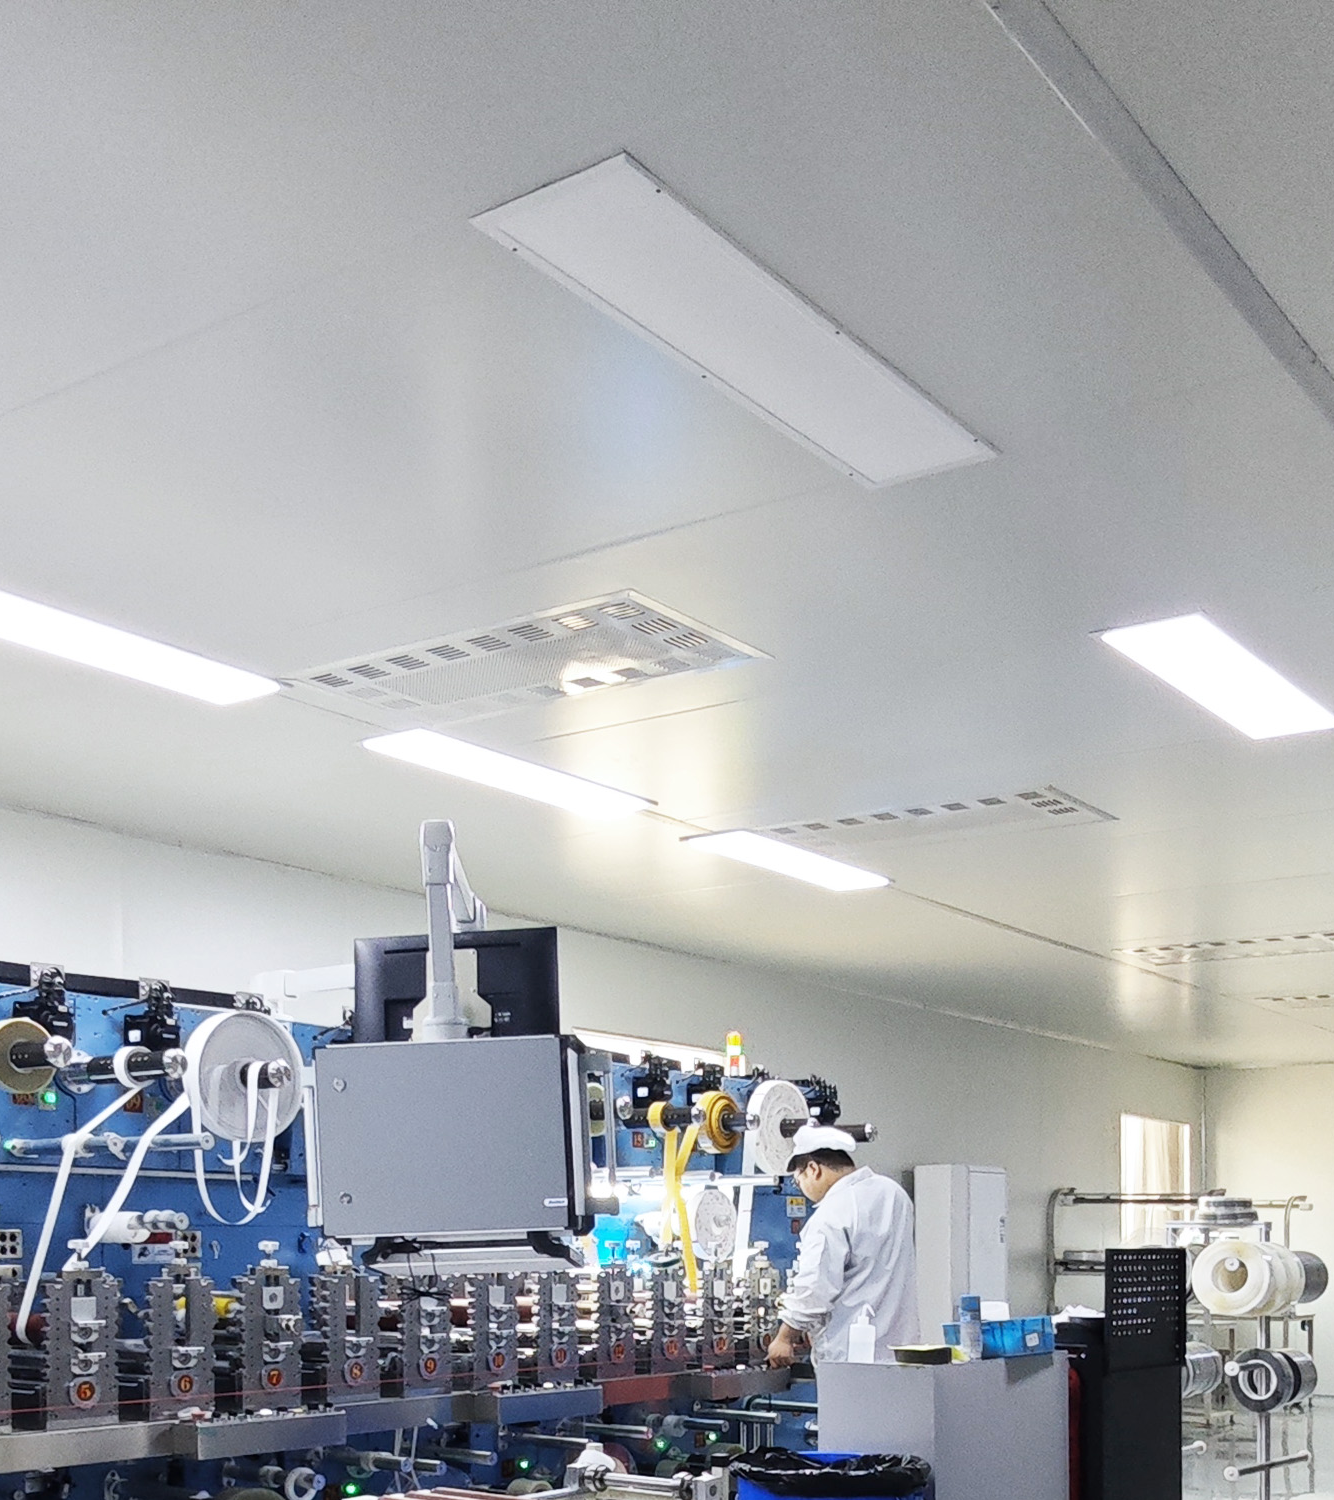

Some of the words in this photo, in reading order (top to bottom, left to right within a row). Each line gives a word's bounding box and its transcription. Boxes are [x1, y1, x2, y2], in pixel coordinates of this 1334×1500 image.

[351, 1364, 362, 1379] 8
[426, 1359, 435, 1372] 9
[180, 1376, 191, 1391] 6
[269, 1370, 279, 1384] 7
[80, 1383, 92, 1399] 5
